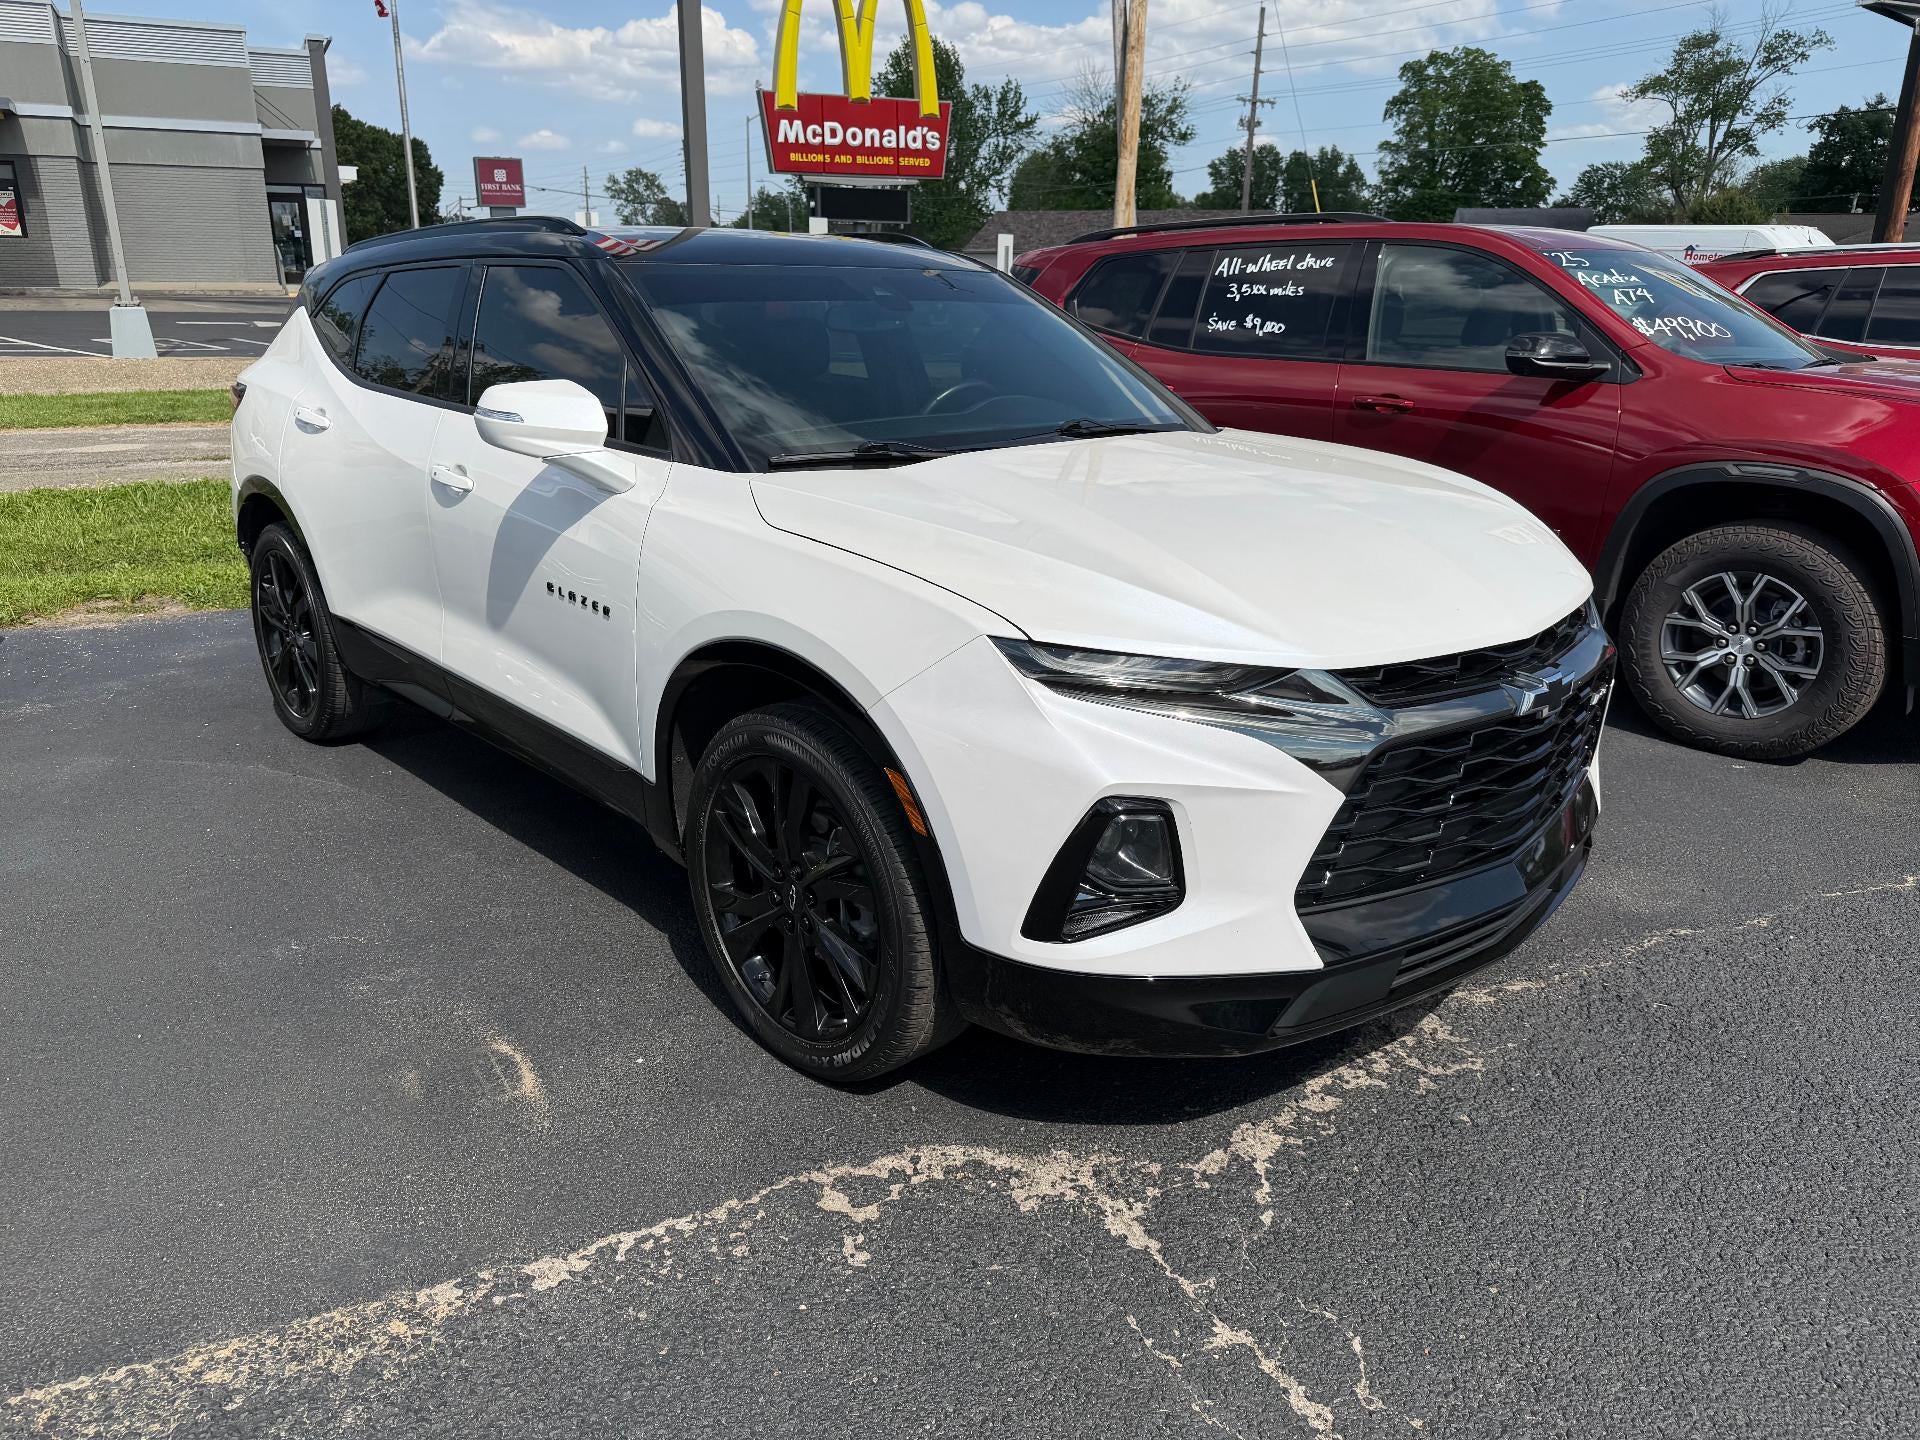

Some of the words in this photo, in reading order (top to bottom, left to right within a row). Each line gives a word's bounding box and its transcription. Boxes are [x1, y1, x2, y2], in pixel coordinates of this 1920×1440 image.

[777, 119, 941, 150] McDonald's
[789, 152, 831, 163] BILLIONS
[834, 154, 852, 164] AND
[856, 155, 894, 165] BILLIONS
[898, 157, 931, 167] SERVED
[480, 183, 500, 191] FIRST
[1684, 250, 1726, 261] Hometo
[1613, 287, 1655, 306] AT4
[1243, 313, 1286, 337] $9,000
[1632, 316, 1732, 342] $49,900
[546, 581, 611, 617] BLAZER
